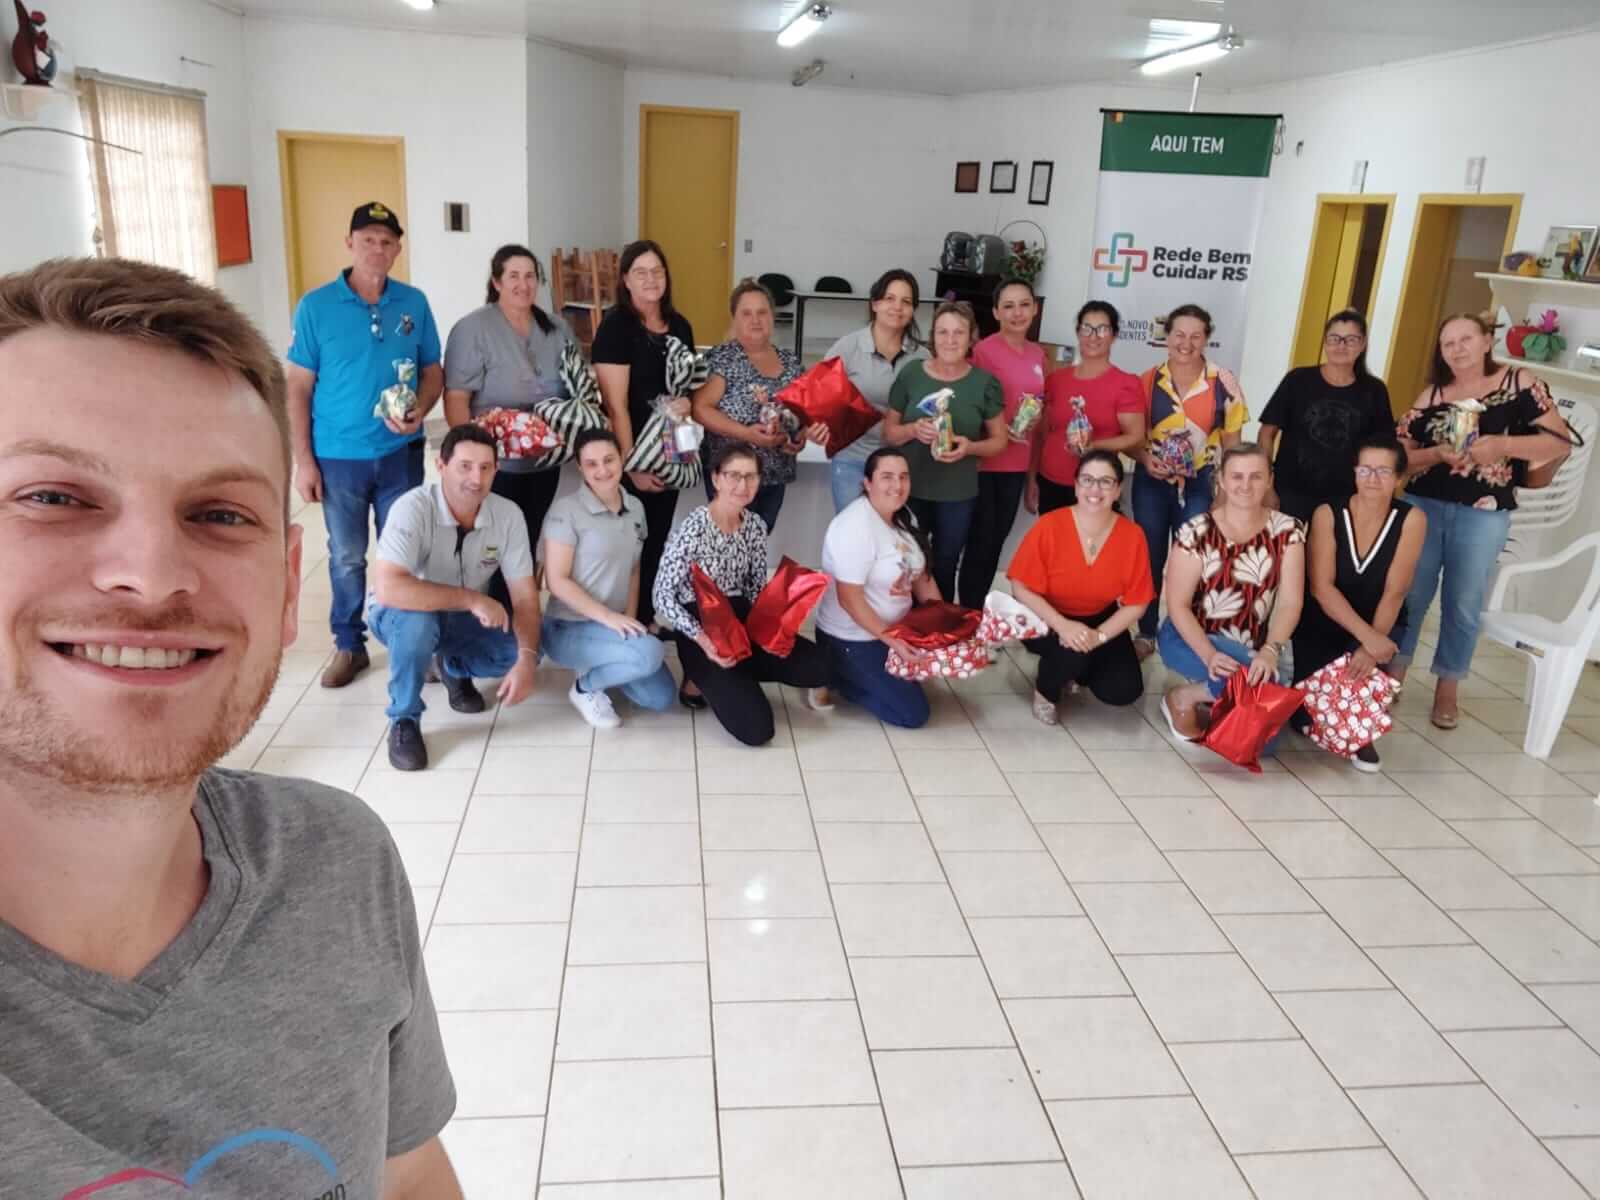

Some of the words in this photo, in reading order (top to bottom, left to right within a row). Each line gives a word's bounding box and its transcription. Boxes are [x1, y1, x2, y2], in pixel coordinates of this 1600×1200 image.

[1150, 134, 1187, 153] AQUI
[1192, 136, 1225, 155] TEM
[1152, 246, 1203, 262] Rede
[1207, 249, 1252, 265] Bem
[1152, 263, 1218, 280] Cuidar
[1221, 266, 1249, 281] RS
